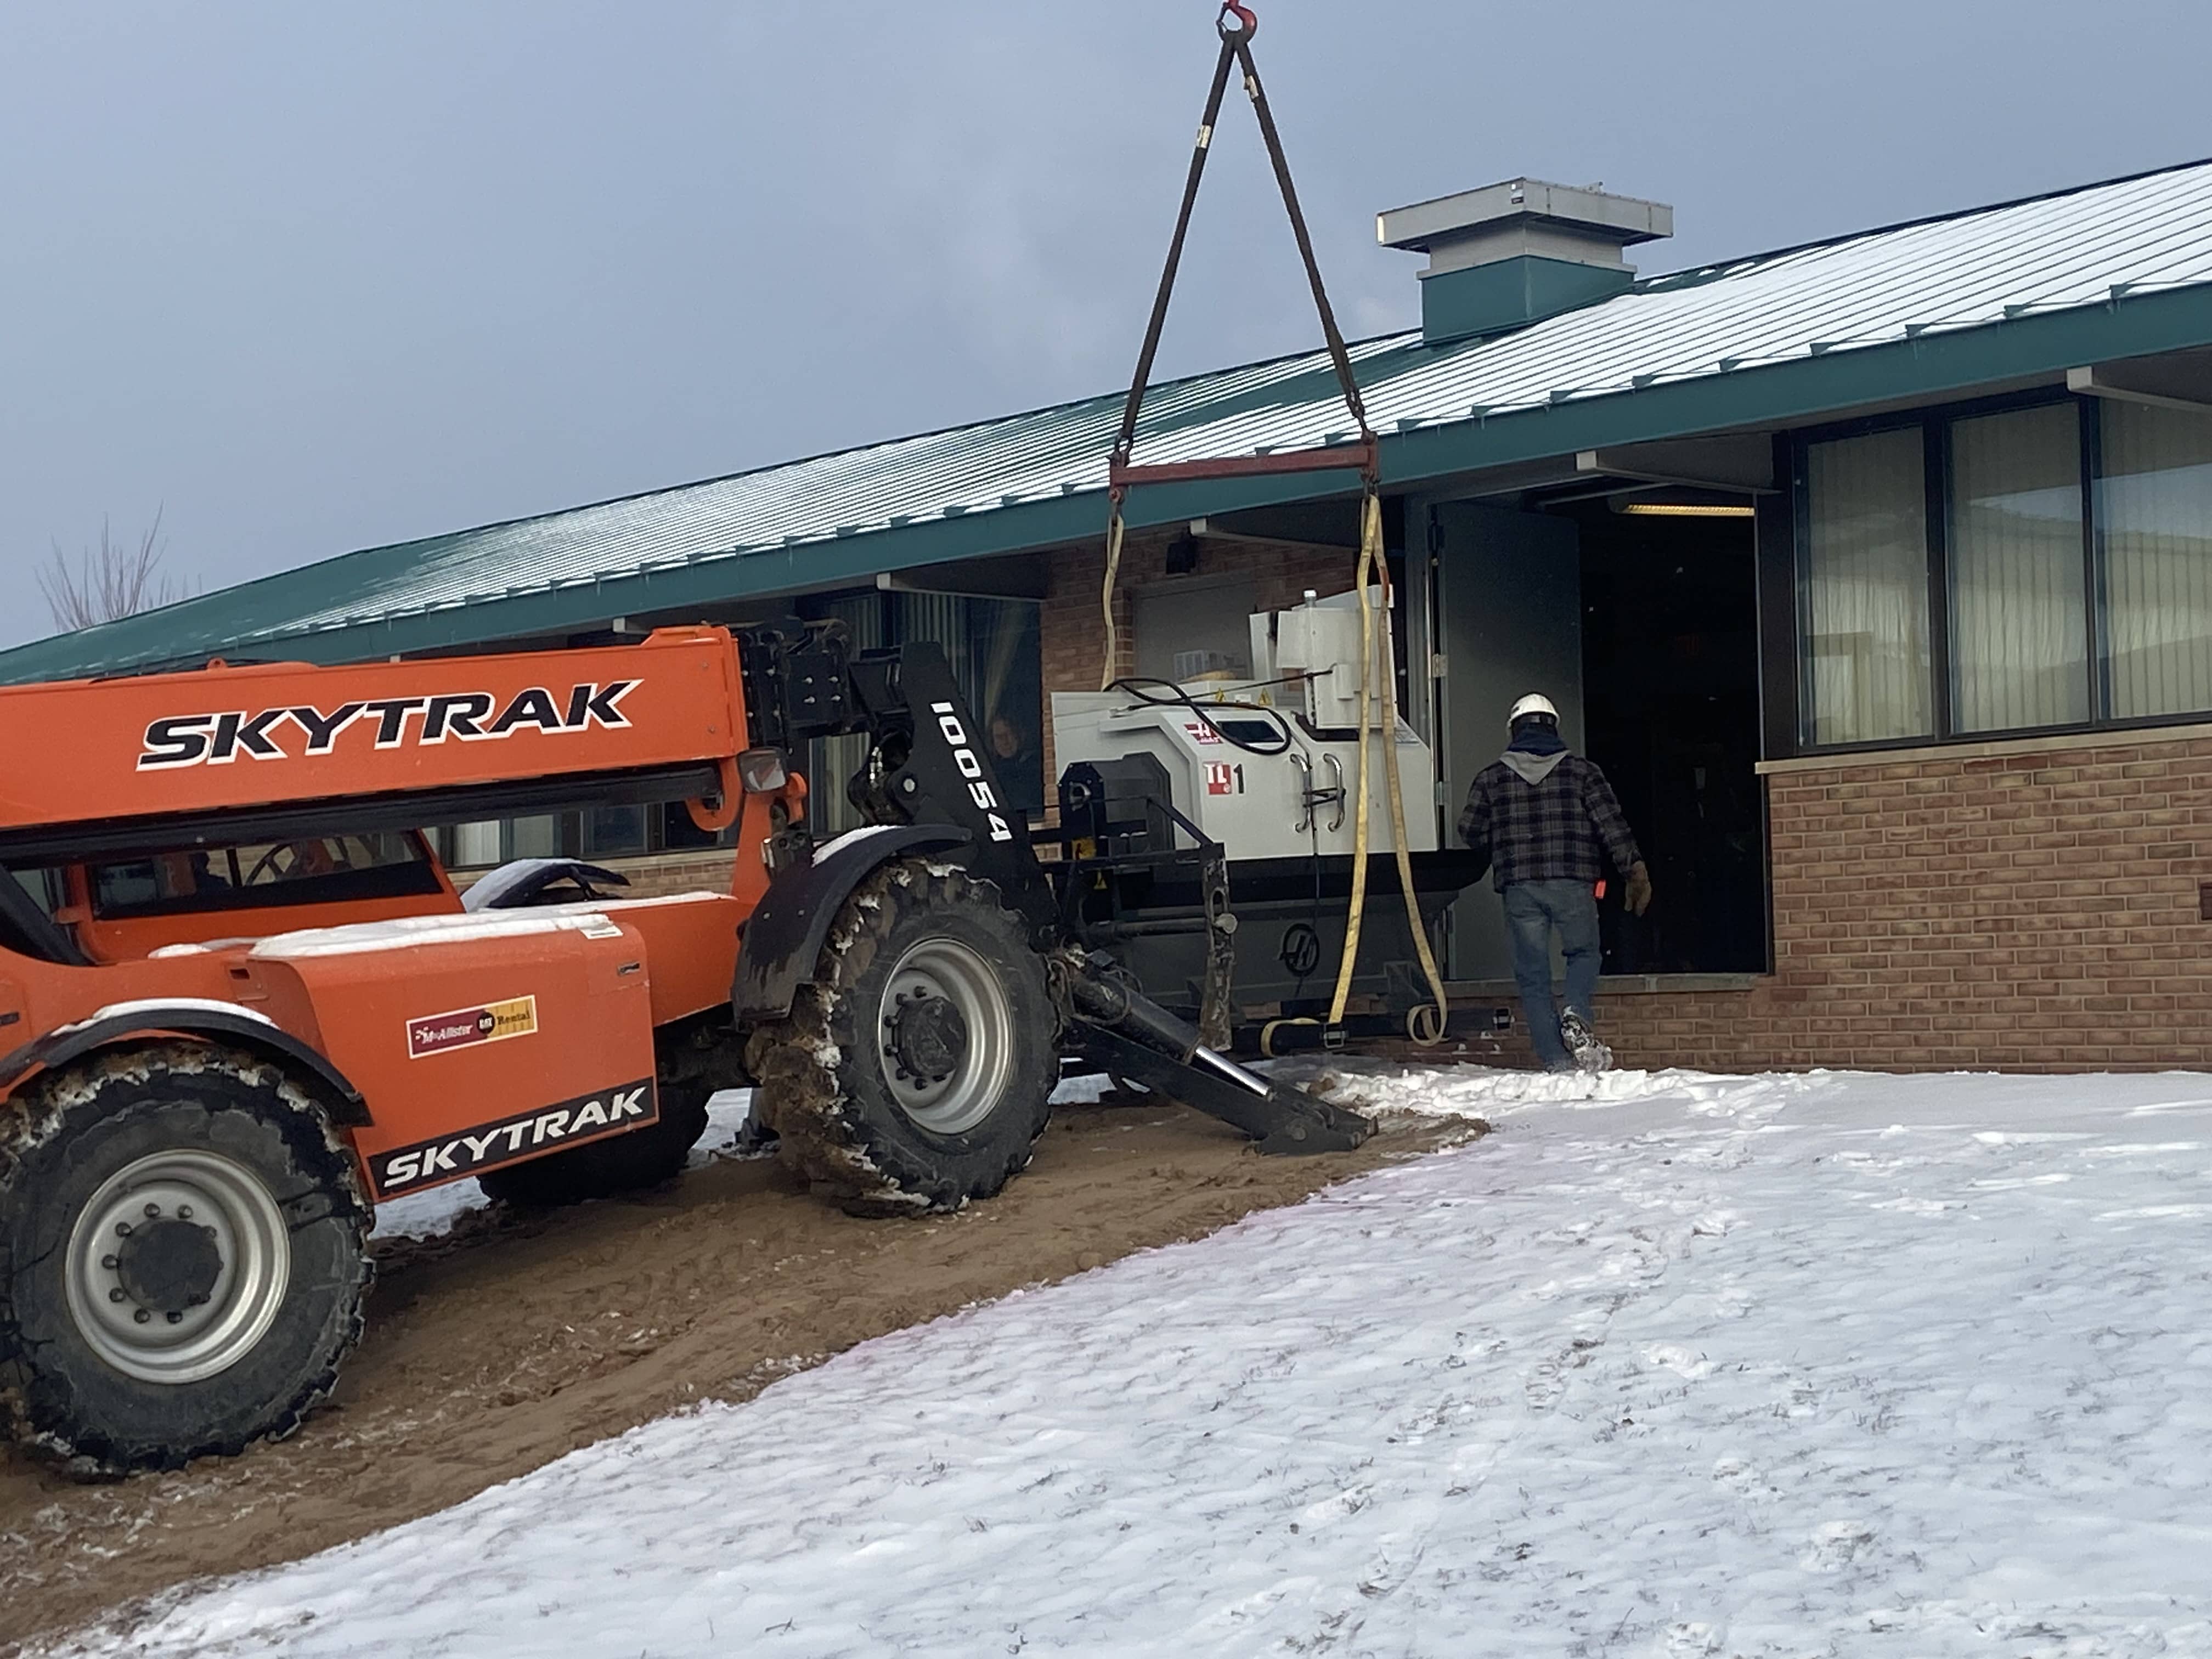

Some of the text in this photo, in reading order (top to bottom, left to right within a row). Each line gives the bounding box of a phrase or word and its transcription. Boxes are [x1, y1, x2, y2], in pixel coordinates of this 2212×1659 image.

[136, 679, 644, 771] SKYTRAK
[930, 702, 1013, 842] 10054
[497, 1011, 531, 1025] Rental
[385, 1086, 647, 1188] SKYTRAK
